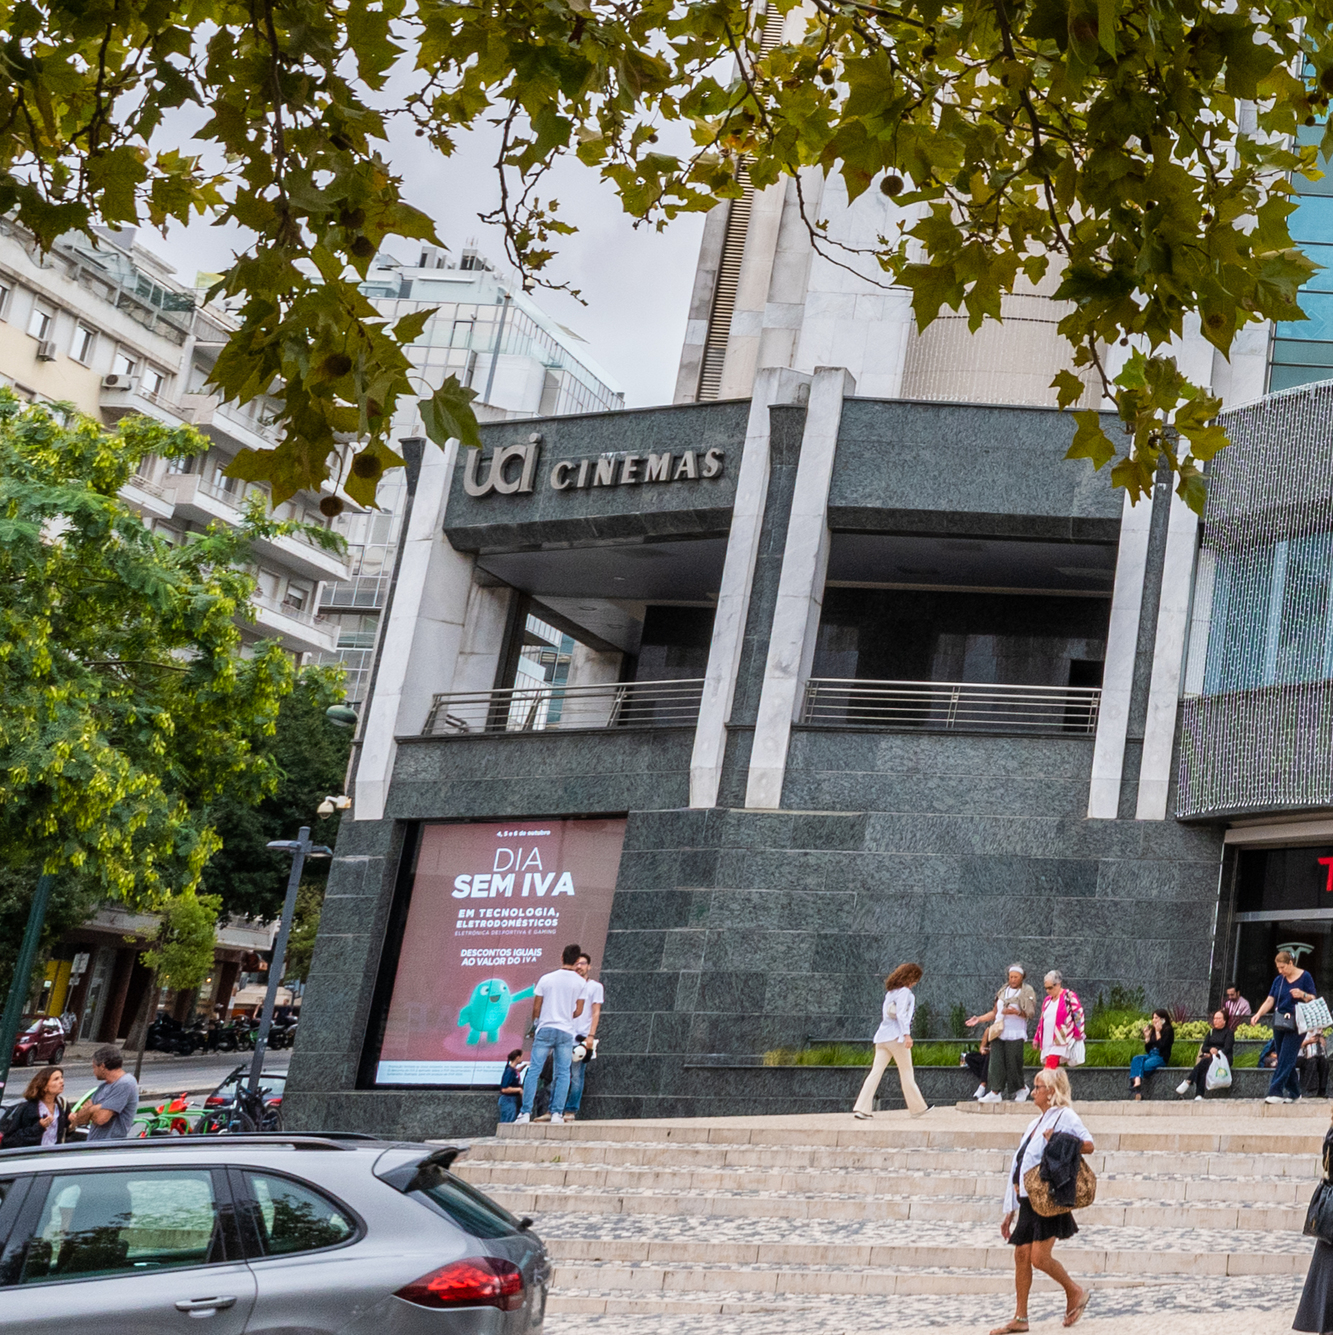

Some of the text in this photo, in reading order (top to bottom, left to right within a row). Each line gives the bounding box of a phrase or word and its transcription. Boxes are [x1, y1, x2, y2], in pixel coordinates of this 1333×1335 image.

[550, 447, 725, 490] CINEMAS
[493, 847, 543, 872] DIA
[451, 871, 575, 898] SEM IVA
[458, 907, 560, 918] EM TECNOLOGIA,
[456, 918, 558, 928] ELETRODOMÉSTICOS
[460, 948, 543, 957] DESCONTOS IGUAIS
[461, 957, 476, 966] AO
[477, 957, 506, 966] VALOR
[507, 956, 520, 965] DO
